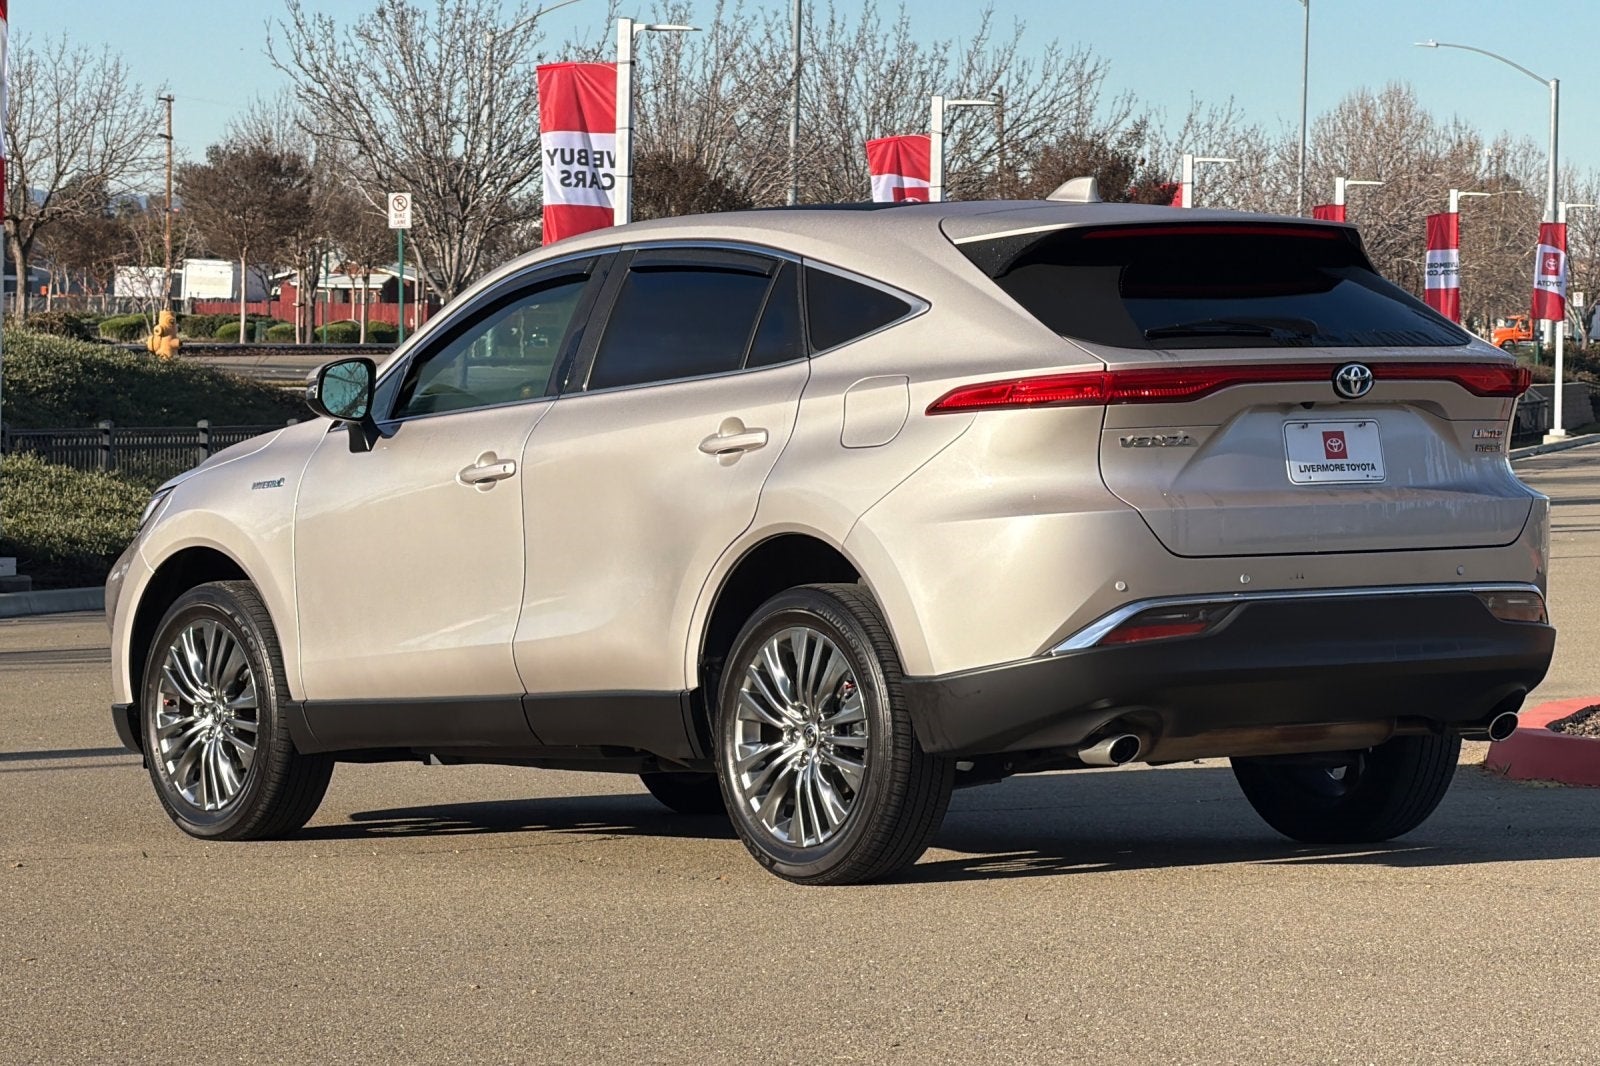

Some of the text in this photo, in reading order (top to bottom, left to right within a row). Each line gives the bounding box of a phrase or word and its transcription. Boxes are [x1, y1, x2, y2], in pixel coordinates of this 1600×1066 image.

[1118, 432, 1199, 448] VENZA
[1298, 462, 1377, 473] LIVERMORE TOYOTA
